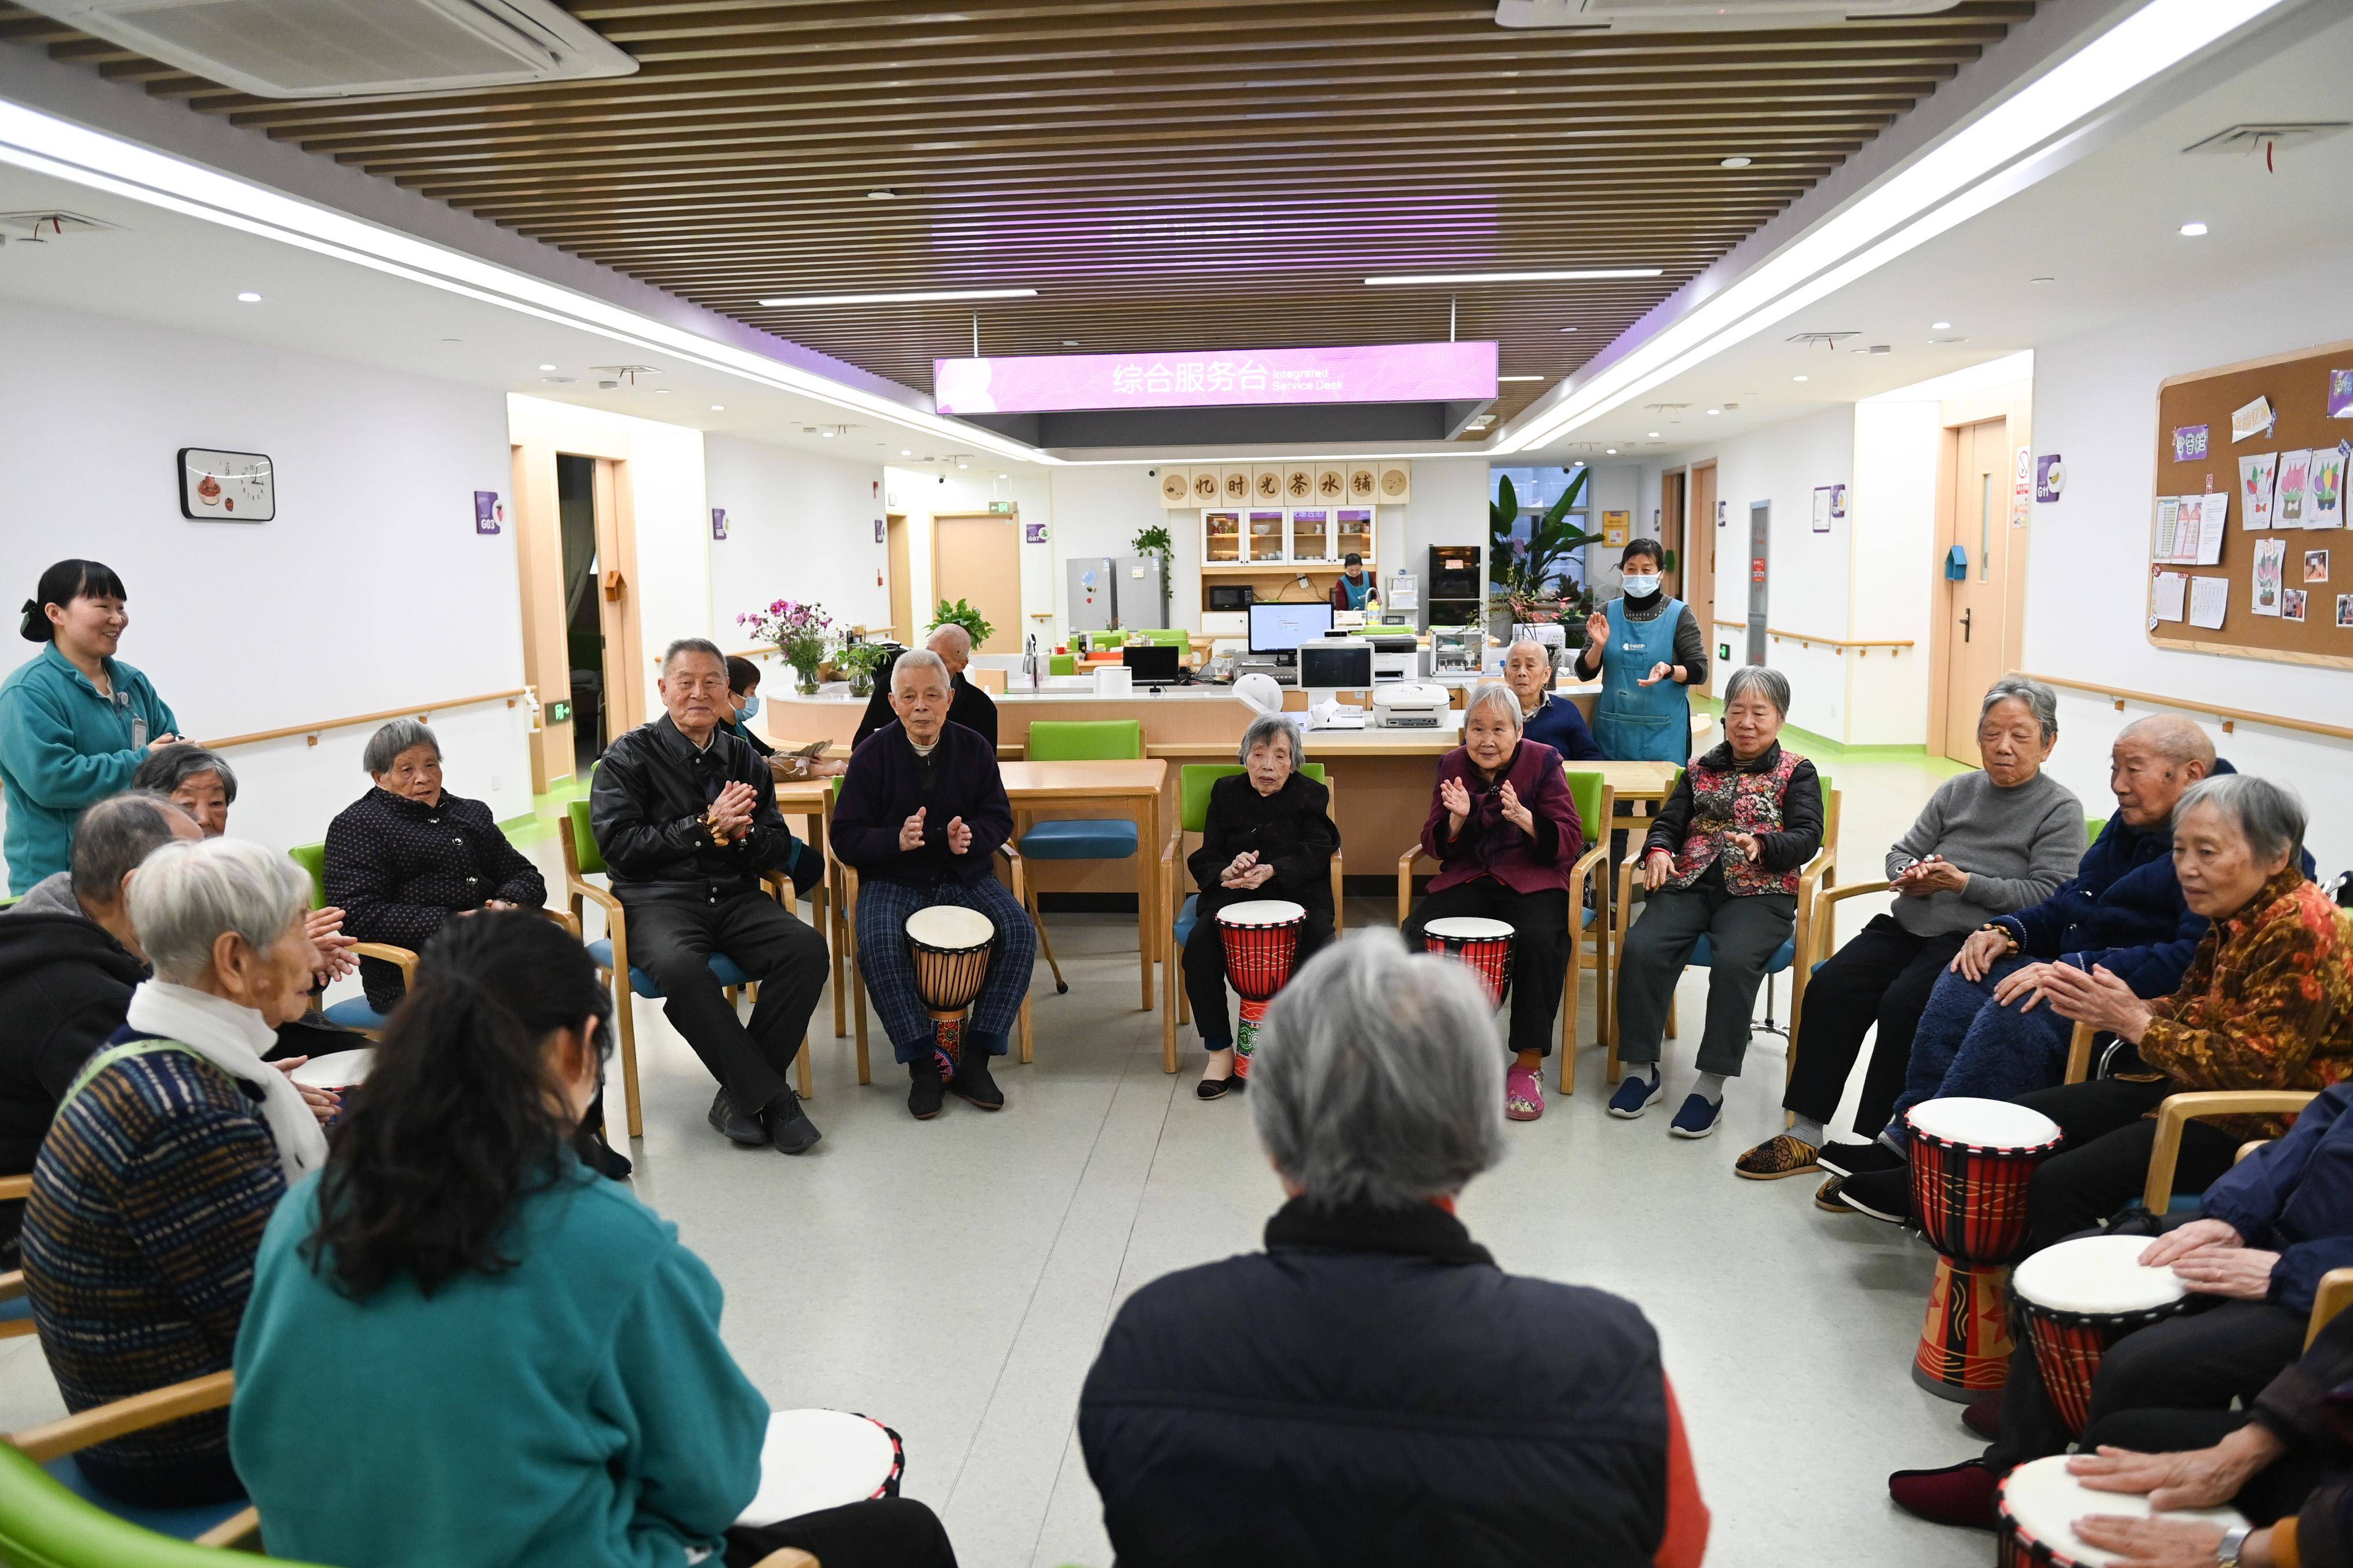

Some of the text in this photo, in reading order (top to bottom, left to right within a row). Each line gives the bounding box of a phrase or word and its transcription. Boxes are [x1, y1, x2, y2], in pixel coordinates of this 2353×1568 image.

[1112, 359, 1268, 394] 综合服务台
[1272, 368, 1328, 380] Integrated
[1272, 379, 1344, 392] Service Desk
[2177, 431, 2206, 454] 公告栏
[1195, 470, 1371, 494] 忆时光茶水铺
[2038, 486, 2049, 497] G11
[481, 519, 495, 529] G03
